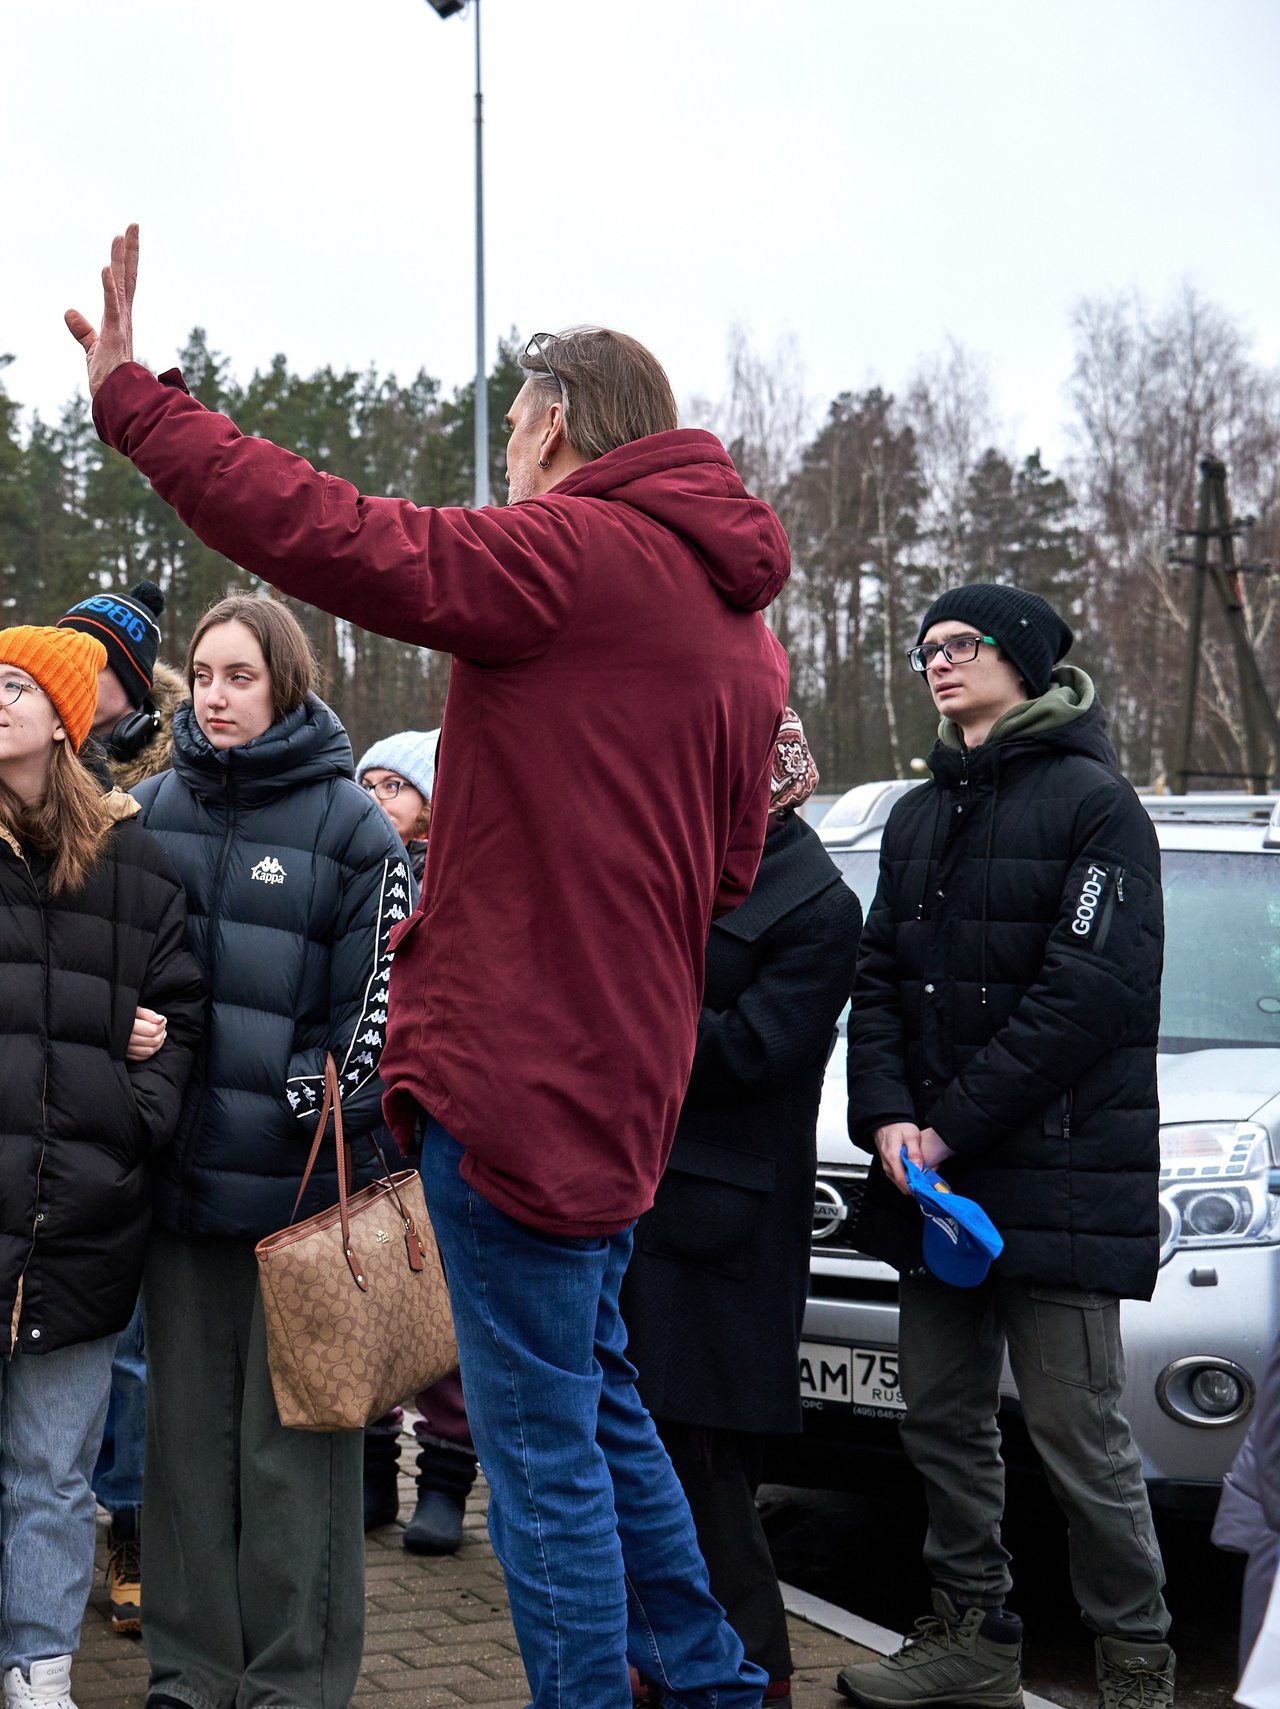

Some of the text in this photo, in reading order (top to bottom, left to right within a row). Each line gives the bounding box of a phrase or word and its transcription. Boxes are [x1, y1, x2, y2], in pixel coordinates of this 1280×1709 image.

[250, 869, 285, 885] Kappa
[1071, 865, 1107, 935] GOOD-7
[800, 1357, 848, 1396] AM
[46, 1667, 65, 1676] CELINE
